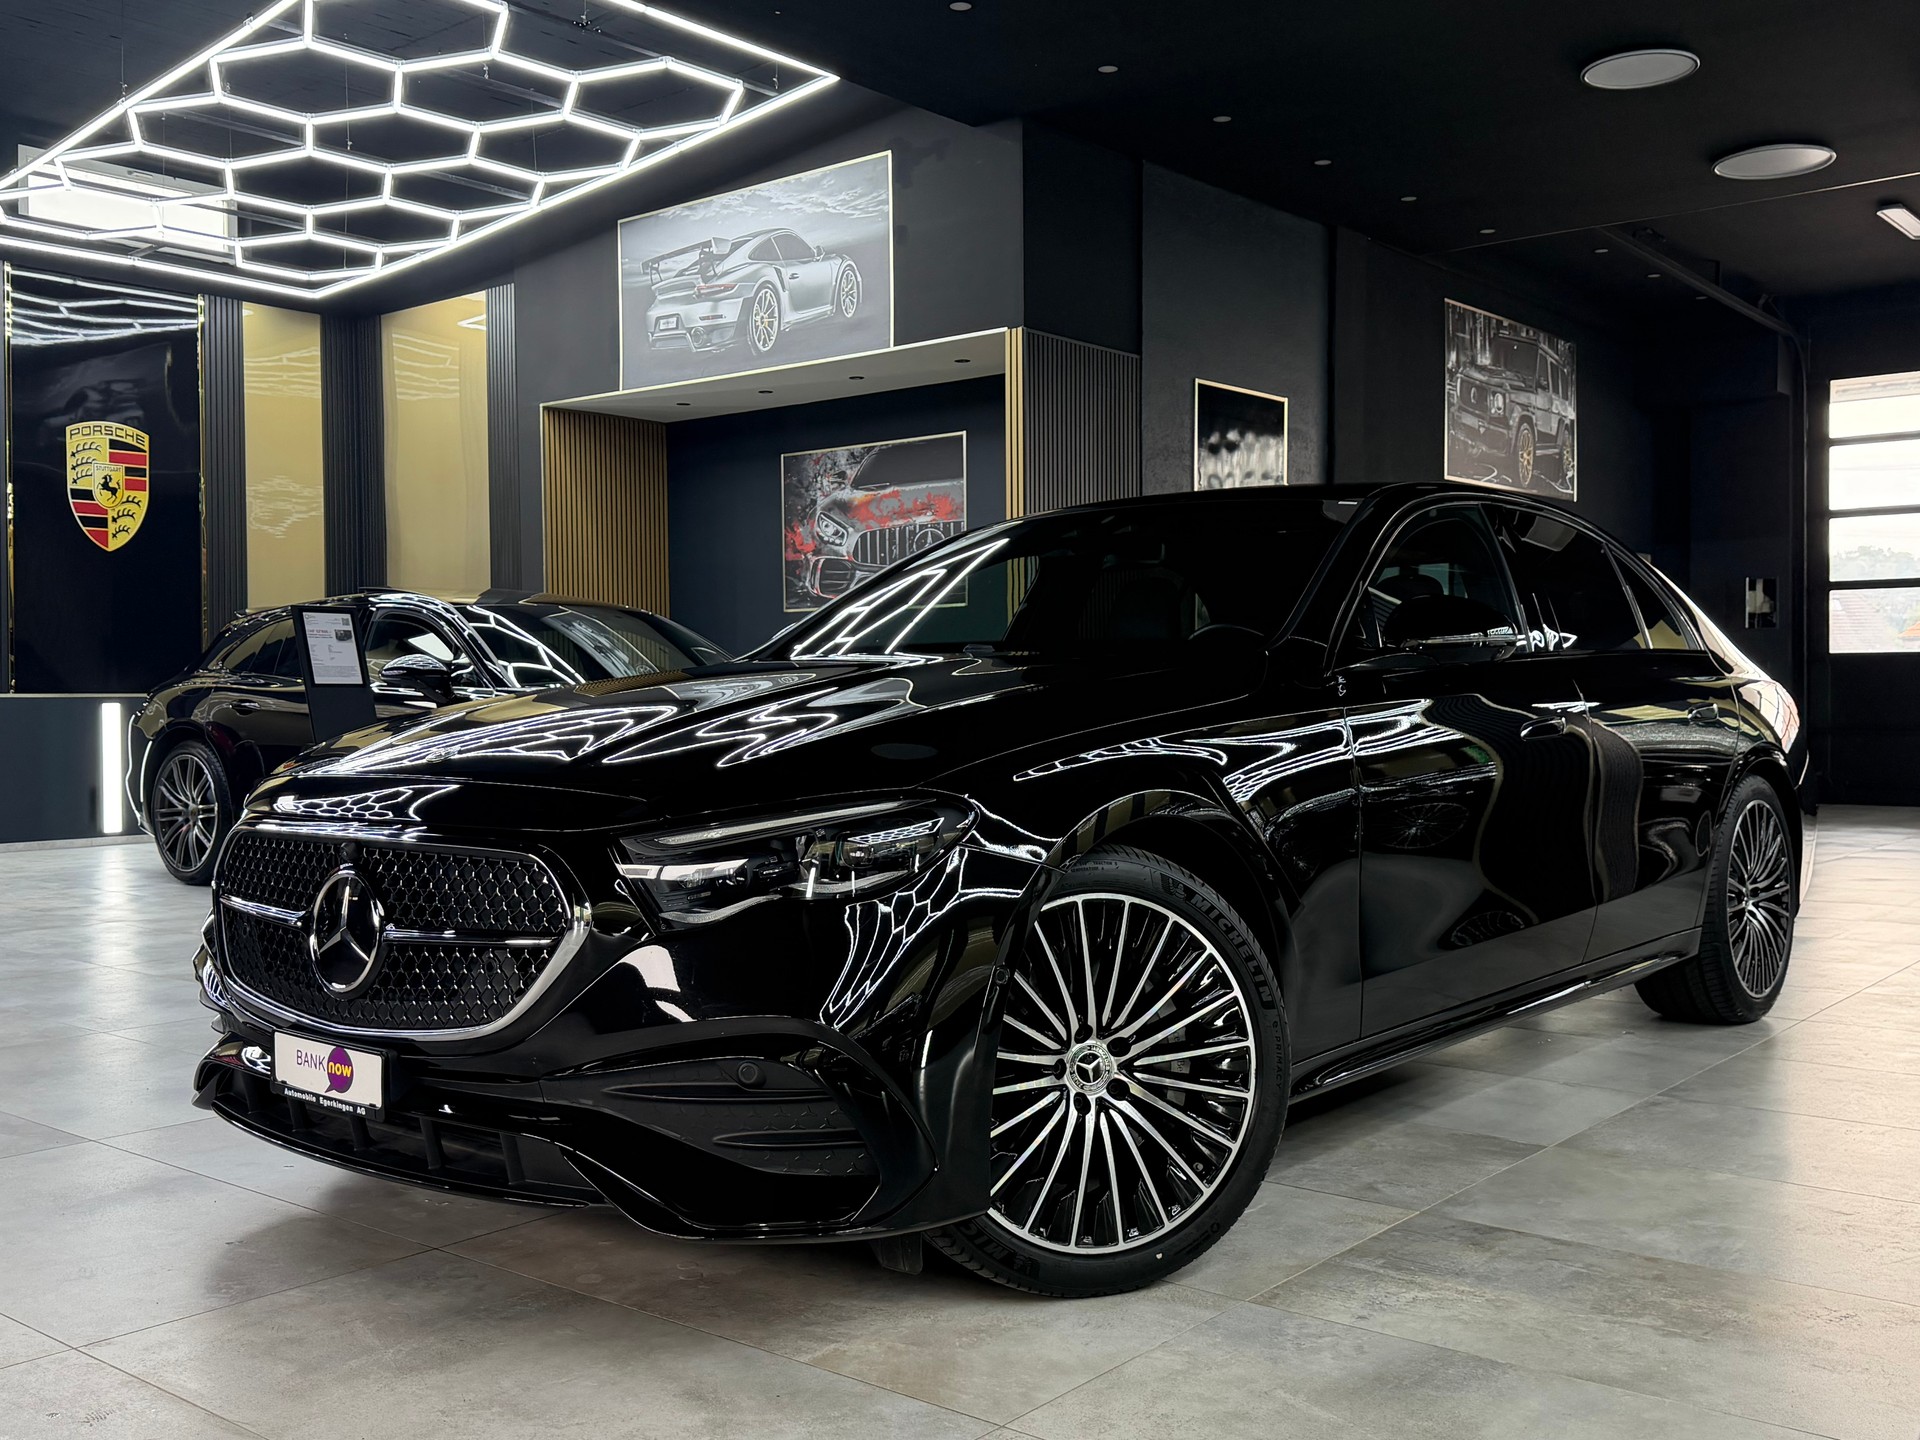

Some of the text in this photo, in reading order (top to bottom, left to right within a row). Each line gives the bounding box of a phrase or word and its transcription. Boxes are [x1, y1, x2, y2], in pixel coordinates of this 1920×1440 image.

[70, 425, 146, 446] PORSCHE
[95, 465, 122, 473] STUTTGART
[1190, 893, 1273, 1002] MICHELIN
[296, 1049, 352, 1078] BANK now
[284, 1087, 366, 1116] Automobile Egerkingen AG
